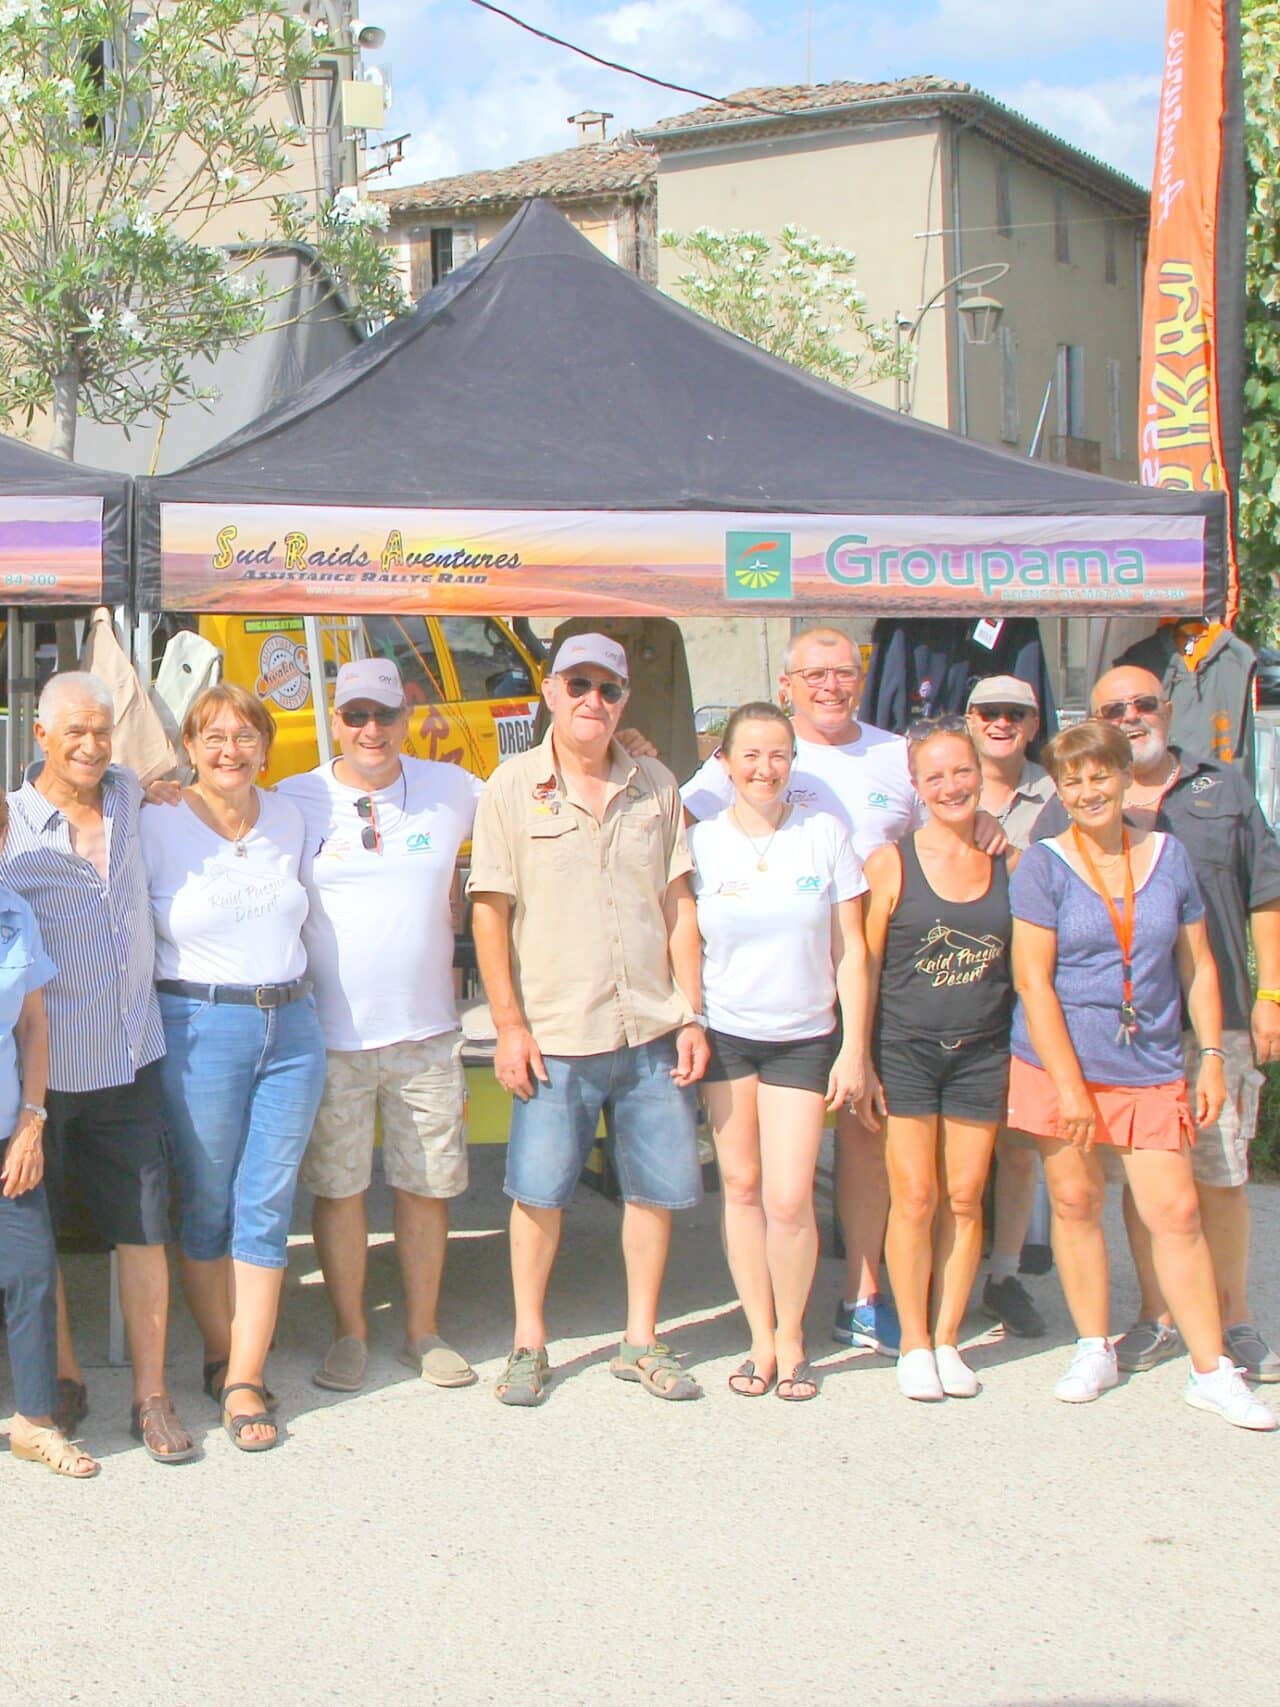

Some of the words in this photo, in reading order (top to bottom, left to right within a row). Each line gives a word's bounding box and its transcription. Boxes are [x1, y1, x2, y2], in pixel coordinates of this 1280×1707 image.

[212, 524, 276, 570] Sud
[284, 530, 370, 571] Raids
[380, 528, 522, 571] Aventures
[825, 534, 1145, 597] Groupama
